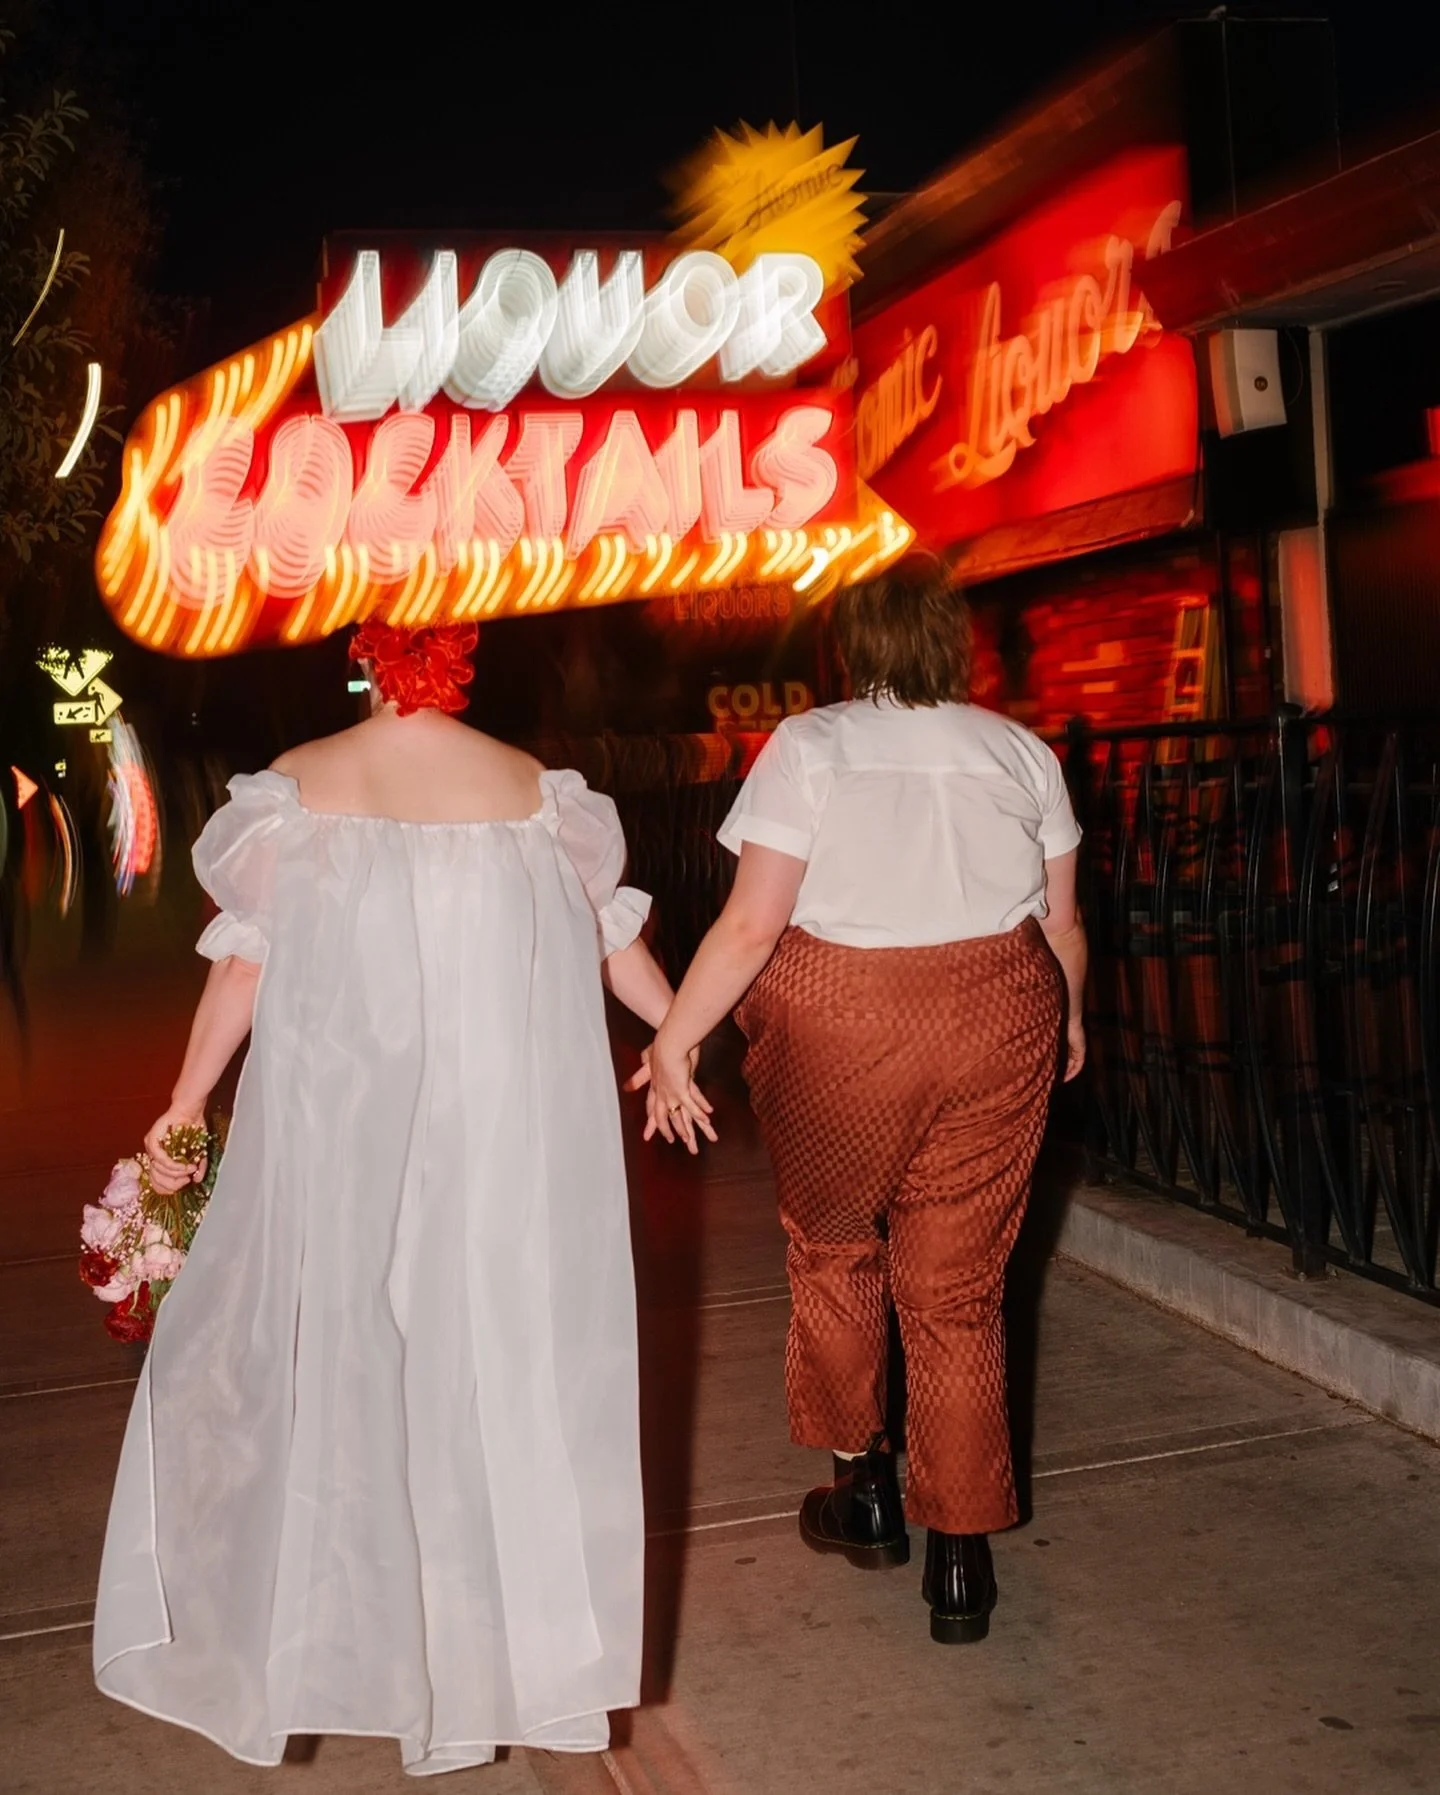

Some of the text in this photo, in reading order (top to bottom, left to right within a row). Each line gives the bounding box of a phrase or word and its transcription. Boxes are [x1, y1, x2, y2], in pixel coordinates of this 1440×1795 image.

[313, 249, 828, 423] LIQUOR
[167, 407, 838, 608] COCKTAILS
[673, 586, 793, 626] LIQUORS
[707, 681, 809, 719] COLD
